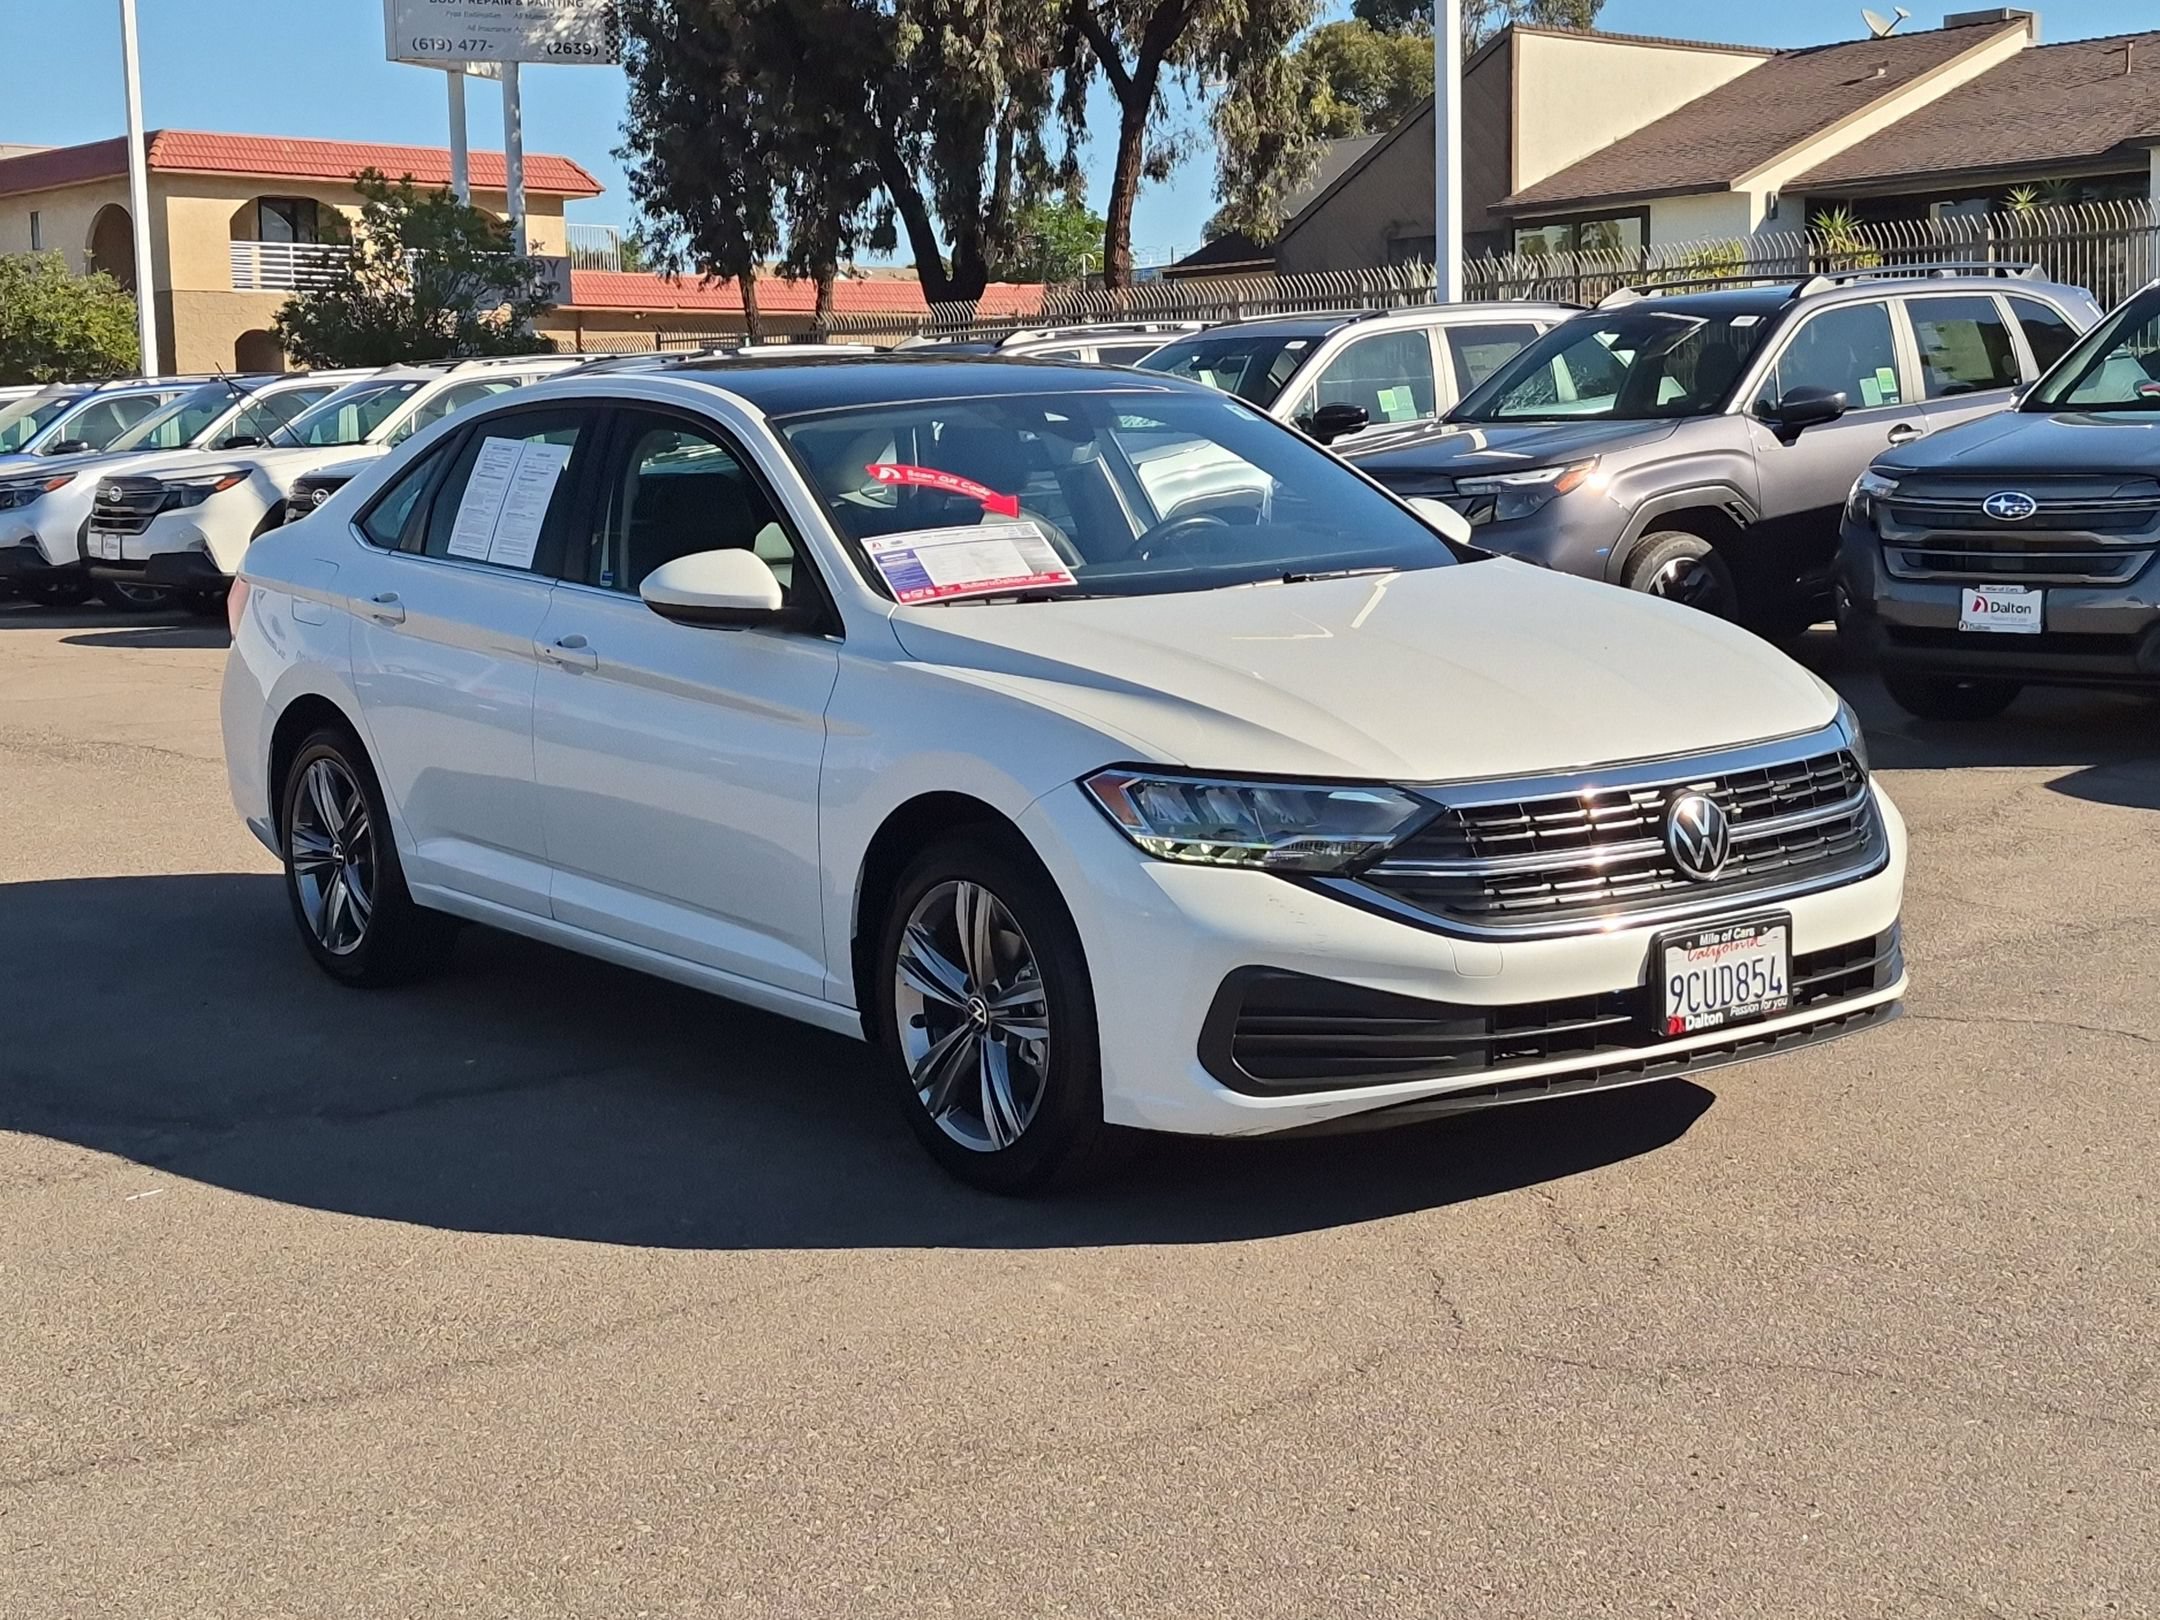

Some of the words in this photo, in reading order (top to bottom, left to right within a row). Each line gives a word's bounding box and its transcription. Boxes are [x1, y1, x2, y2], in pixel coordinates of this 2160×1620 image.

[412, 37, 452, 52] (619)
[458, 39, 494, 51] 477-
[547, 42, 599, 57] (2639)
[1990, 601, 2032, 614] Dalton
[1699, 933, 1720, 946] Mile
[1721, 929, 1732, 941] of
[1733, 927, 1755, 939] Cars
[1670, 956, 1783, 1015] 9CUD854
[1685, 1011, 1724, 1032] Dalton
[1729, 1002, 1760, 1017] Passion
[1760, 999, 1773, 1010] for
[1773, 997, 1788, 1010] you
